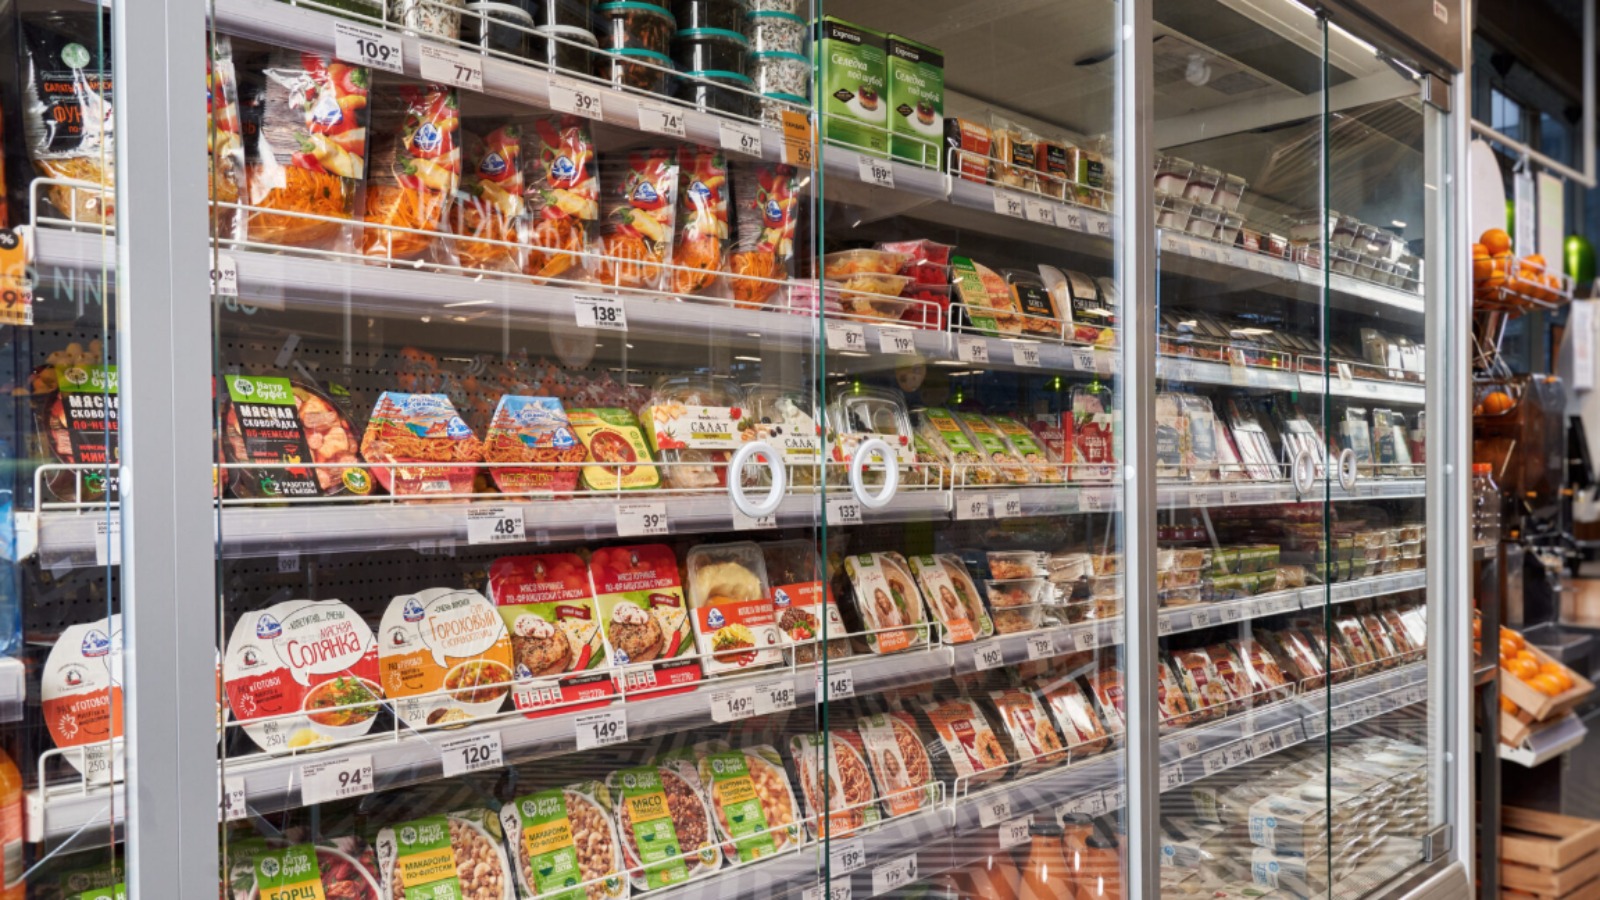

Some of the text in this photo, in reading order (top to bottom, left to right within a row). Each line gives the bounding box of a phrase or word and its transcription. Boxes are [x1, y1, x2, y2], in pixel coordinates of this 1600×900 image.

[356, 39, 390, 61] 109
[832, 53, 867, 71] Селедка
[454, 64, 472, 81] 77
[575, 92, 592, 109] 39
[662, 113, 677, 129] 74
[741, 136, 754, 148] 67
[798, 149, 810, 161] 59
[872, 166, 887, 181] 189
[592, 306, 616, 321] 138
[846, 332, 858, 344] 87
[894, 338, 907, 350] 119
[240, 405, 294, 419] МЯСНАЯ
[242, 419, 298, 429] СКОВОРОДКА
[691, 421, 728, 433] САЛАТ
[246, 430, 300, 439] ПО-НЕМЕЦКИ
[273, 482, 280, 491] 2
[839, 505, 855, 518] 133
[971, 502, 981, 512] 69
[1006, 501, 1016, 511] 69
[494, 519, 514, 534] 48
[643, 514, 659, 527] 39
[321, 620, 353, 639] МЯСНАЯ
[429, 609, 496, 641] Гороховый
[288, 631, 361, 669] Солянка
[830, 680, 847, 692] 145
[771, 689, 788, 703] 148
[727, 698, 747, 713] 149
[409, 710, 421, 721] 250
[593, 721, 617, 739] 149
[266, 734, 281, 746] 250
[462, 745, 490, 765] 120
[89, 760, 105, 773] 250
[338, 769, 361, 788] 94
[633, 796, 661, 809] МЯСО
[529, 826, 567, 841] МАКАРОНЫ
[405, 855, 451, 871] МАКАРОНЫ
[842, 852, 858, 867] 139
[406, 863, 453, 879] ПО-ФЛОТСКИ
[270, 886, 316, 900] БОРЩ
